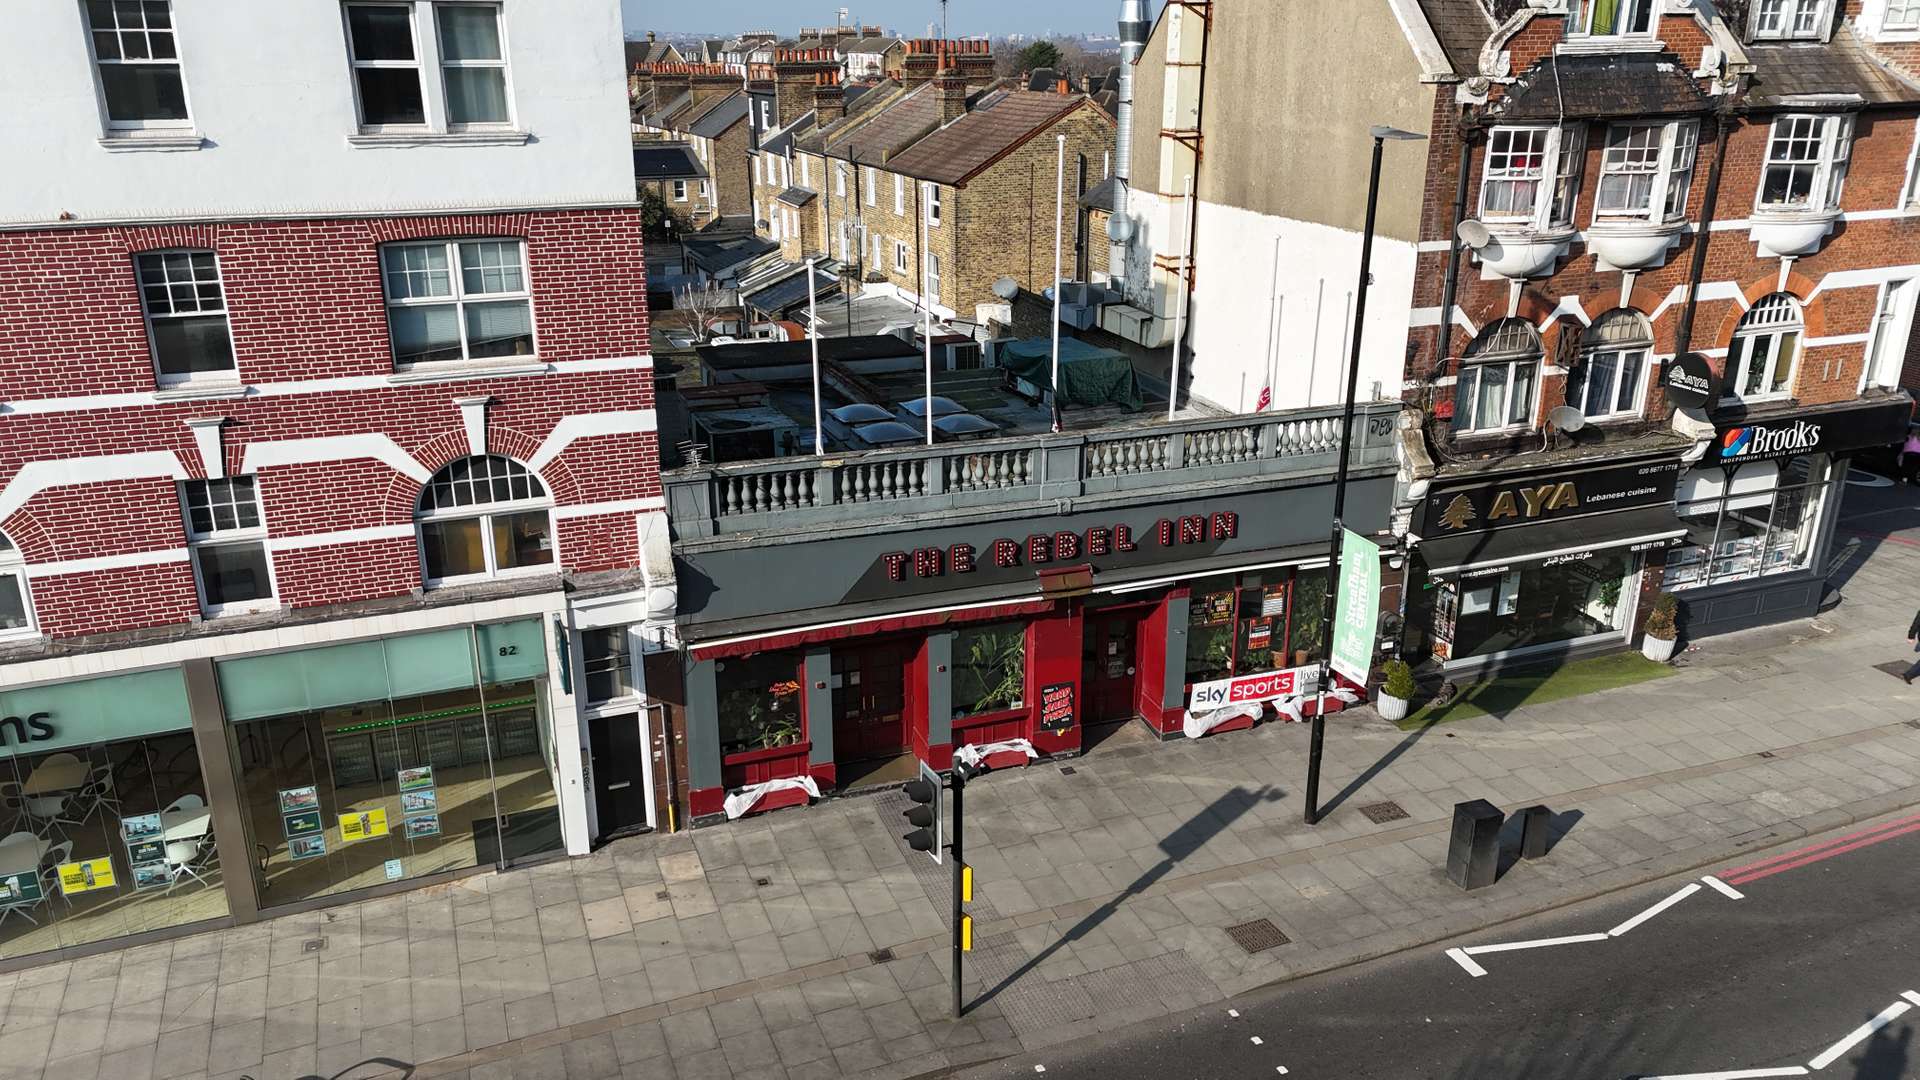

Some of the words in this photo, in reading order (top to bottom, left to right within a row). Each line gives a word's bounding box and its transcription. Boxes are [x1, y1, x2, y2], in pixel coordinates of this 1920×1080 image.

[1684, 376, 1709, 390] AYA
[1751, 421, 1822, 455] Brooks
[1487, 481, 1581, 519] AYA
[1586, 489, 1626, 503] Lebanese
[1627, 485, 1657, 498] cuisine
[882, 543, 976, 582] THE
[994, 523, 1137, 568] REBEL
[1157, 511, 1237, 546] INN
[499, 645, 517, 657] 82
[1300, 669, 1319, 680] live
[1196, 685, 1227, 704] sky
[1233, 676, 1291, 699] sports
